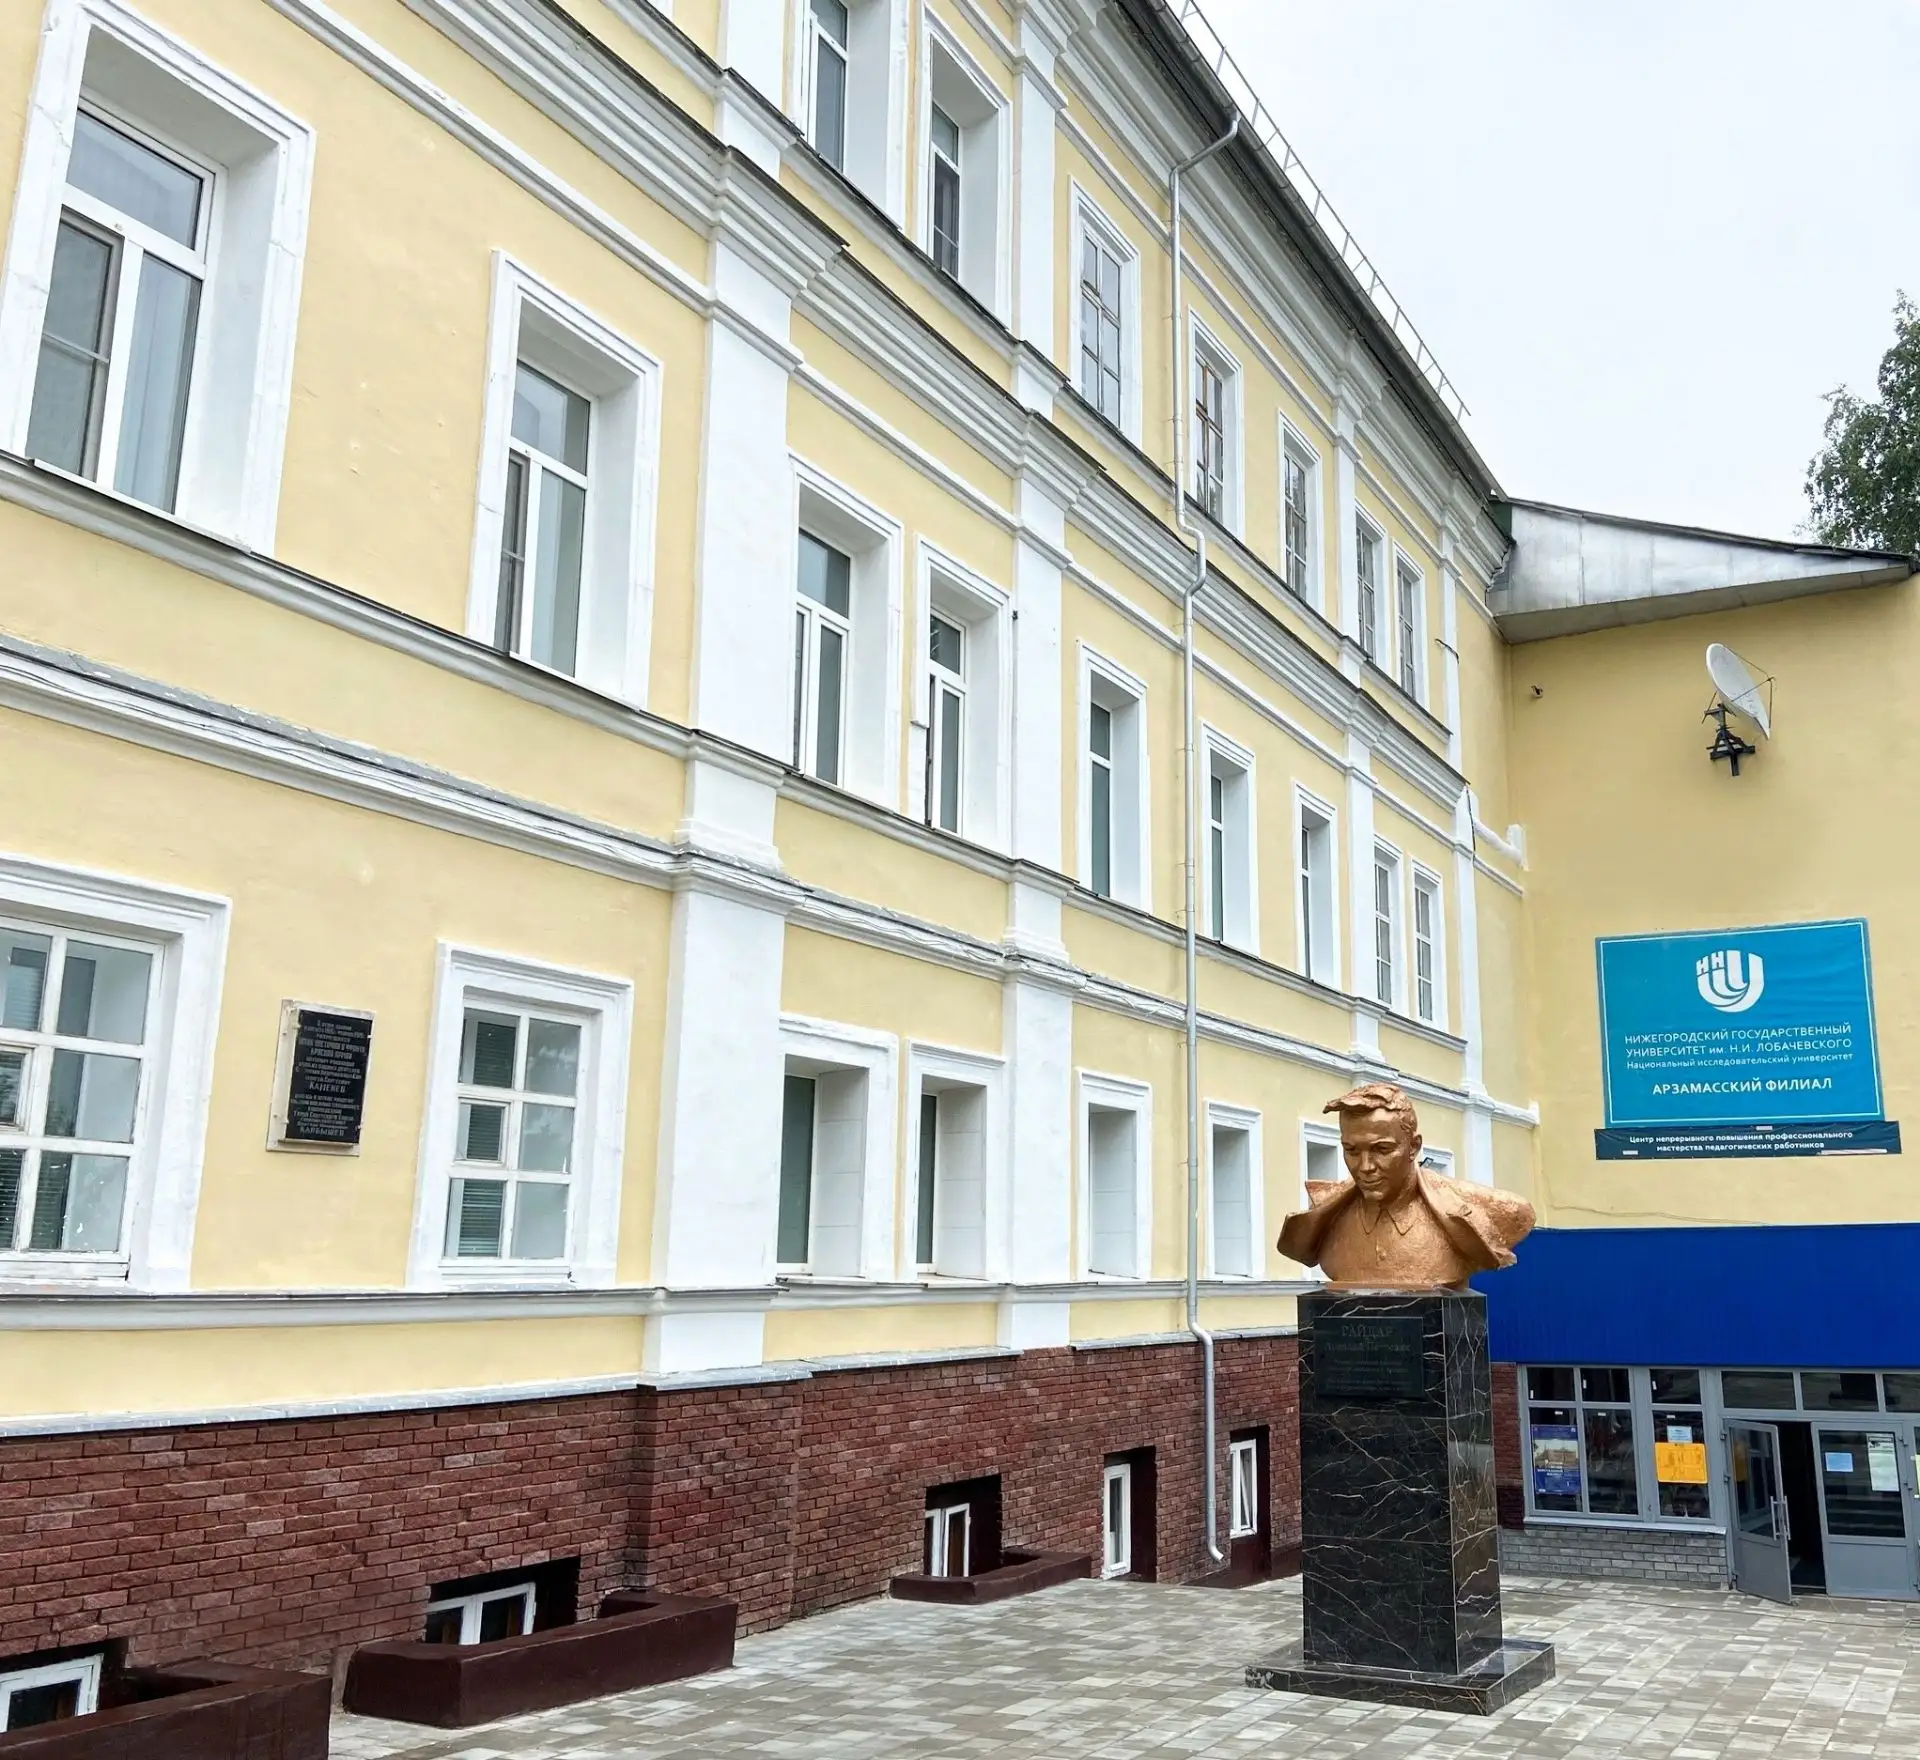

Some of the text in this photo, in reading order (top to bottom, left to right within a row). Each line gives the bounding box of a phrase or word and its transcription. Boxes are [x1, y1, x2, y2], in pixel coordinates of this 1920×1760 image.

[1625, 1021, 1851, 1044] НИЖЕГОРОДСКИЙ ГОСУДАРСТВЕННЫЙ
[1626, 1045, 1706, 1058] УНИВЕРСИТЕТ
[1730, 1043, 1755, 1053] Н.И.
[1756, 1038, 1853, 1053] ЛОБАЧЕВСКОГО
[1626, 1053, 1854, 1070] Национальный исследовательский университет
[1652, 1077, 1833, 1095] АРЗАМАССКИЙ ФИЛИАЛ
[1629, 1131, 1853, 1144] Центр непрерывного повышения профессионального
[1656, 1141, 1825, 1152] мастерства педагогических работников
